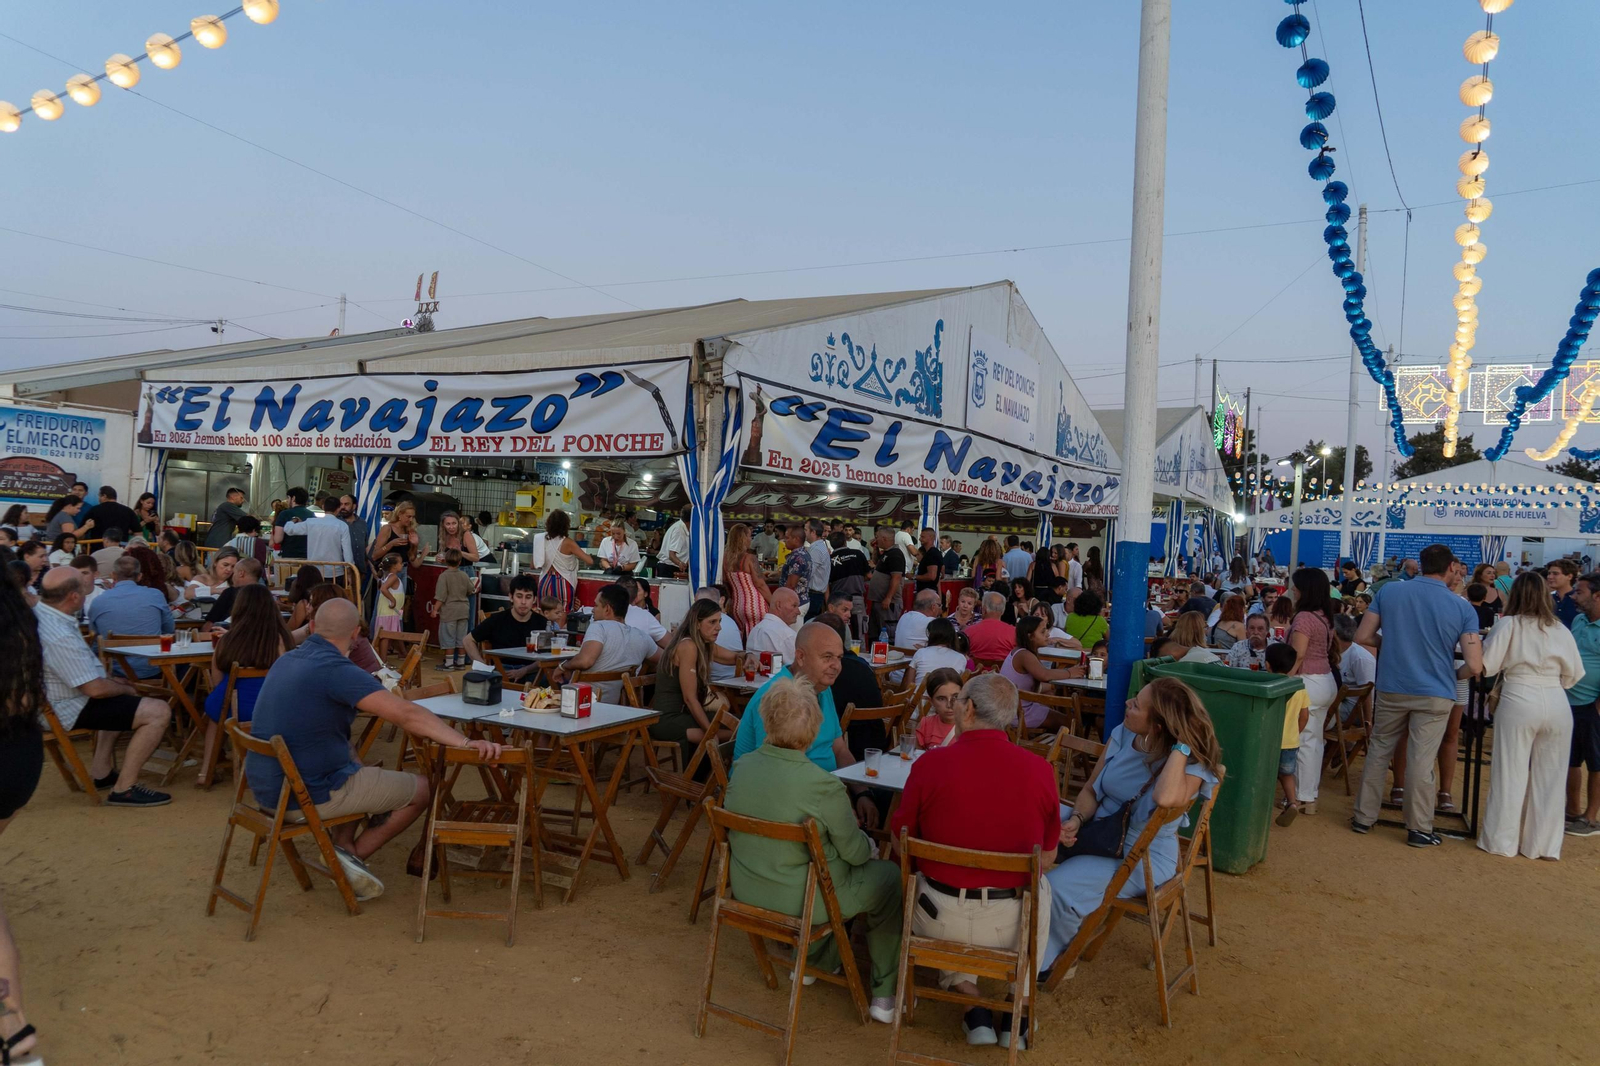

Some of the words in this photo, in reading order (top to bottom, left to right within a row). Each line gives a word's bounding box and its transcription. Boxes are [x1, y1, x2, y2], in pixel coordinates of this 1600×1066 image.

[993, 362, 1005, 383] REY
[1004, 367, 1015, 389] DEL
[1016, 373, 1035, 398] PONCHE
[995, 394, 1002, 413] EL
[1003, 396, 1030, 424] NAVAJAZO
[16, 413, 94, 435] FREIDURIA
[7, 429, 23, 444] EL
[27, 431, 101, 452] MERCADO
[153, 430, 166, 443] En
[169, 431, 191, 444] 2025
[193, 432, 225, 446] hemos
[228, 433, 258, 447] hecho
[262, 434, 283, 448] 100
[286, 433, 312, 448] años
[316, 433, 330, 448] de
[333, 433, 392, 449] tradición
[429, 436, 456, 452] EL
[461, 436, 504, 452] REY
[510, 436, 555, 453] DEL
[563, 433, 664, 452] PONCHE
[6, 445, 37, 455] PEDIDO
[50, 449, 65, 458] 624
[69, 451, 82, 459] 117
[85, 453, 99, 461] 825
[426, 457, 455, 468] RE
[384, 470, 405, 482] EL
[766, 448, 793, 471] En
[799, 457, 841, 479] 2025
[845, 464, 894, 486] hemos
[897, 472, 937, 491] hecho
[942, 479, 956, 492] 100
[981, 485, 992, 498] de
[995, 489, 1034, 507] tradición
[1053, 498, 1065, 512] EL
[1454, 509, 1502, 519] PROVINCIAL
[1503, 510, 1513, 519] DE
[1515, 510, 1547, 520] HUELVA
